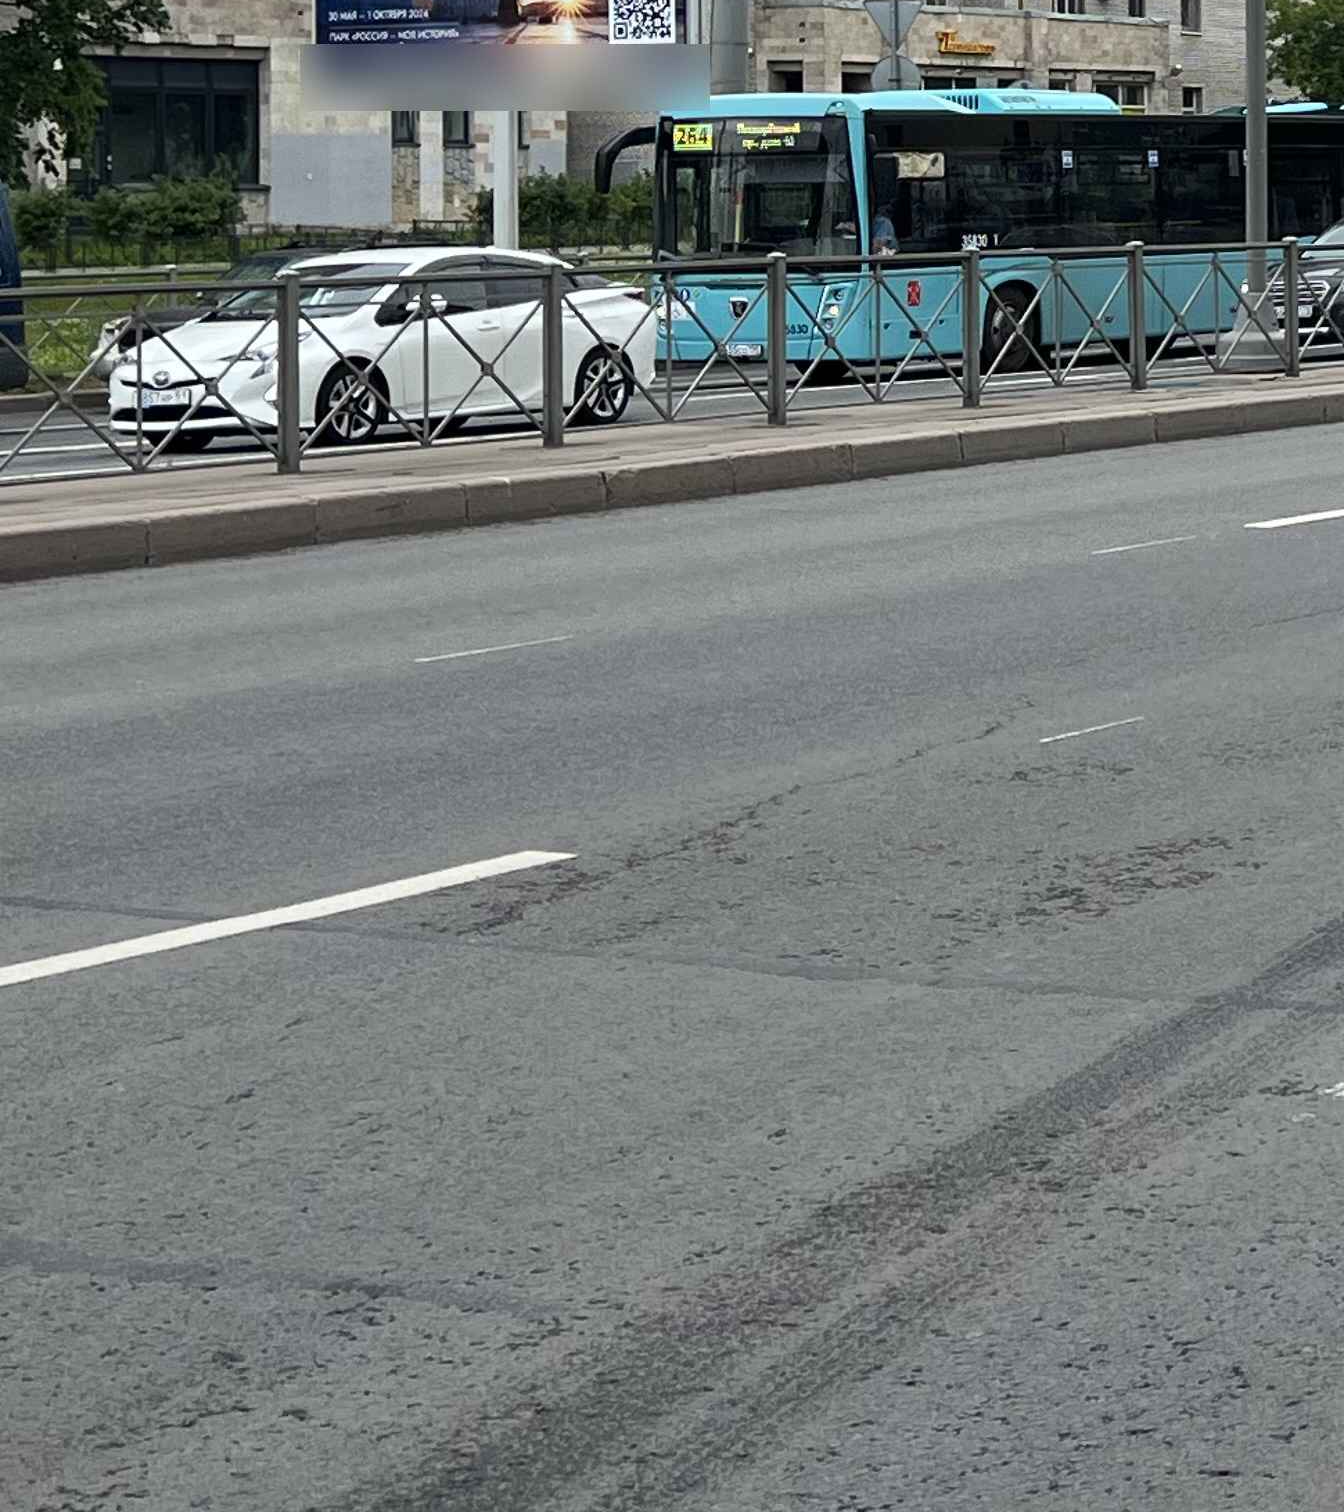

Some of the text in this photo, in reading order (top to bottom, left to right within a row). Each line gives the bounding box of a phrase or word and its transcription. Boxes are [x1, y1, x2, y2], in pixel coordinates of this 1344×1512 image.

[328, 11, 338, 21] 30
[340, 10, 357, 20] МАЯ
[373, 9, 407, 20] ОКТЯБРЯ
[329, 31, 350, 41] ПАРК
[674, 126, 708, 145] 264
